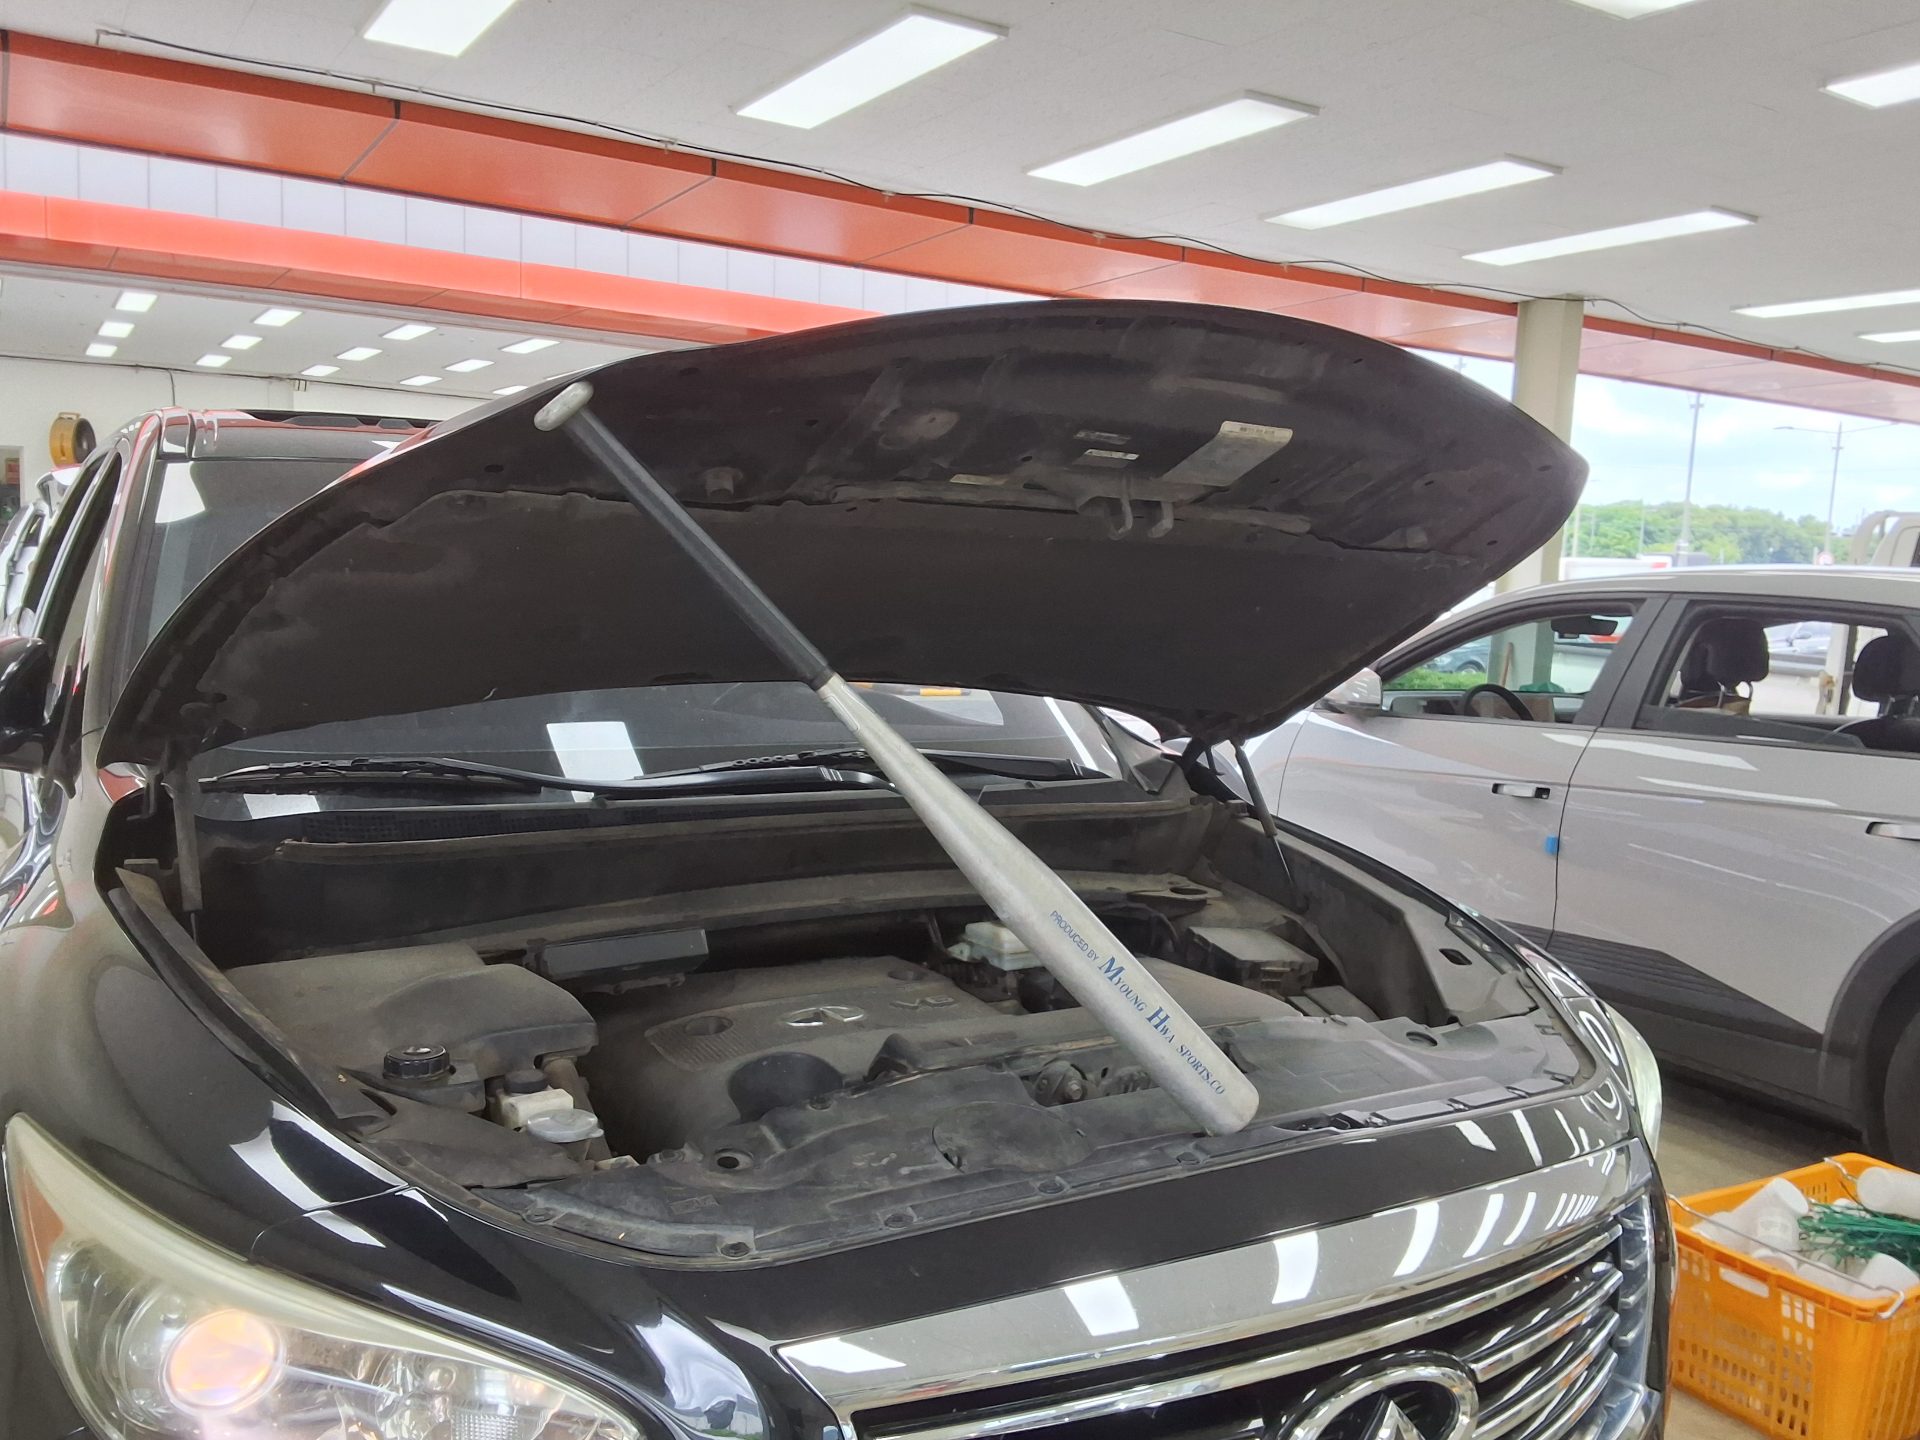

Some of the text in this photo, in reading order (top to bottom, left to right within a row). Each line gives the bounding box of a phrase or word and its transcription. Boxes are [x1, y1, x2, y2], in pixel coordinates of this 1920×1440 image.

[1050, 910, 1226, 1095] PRODUCED BY MYOUNG HWA SPORTS.CO
